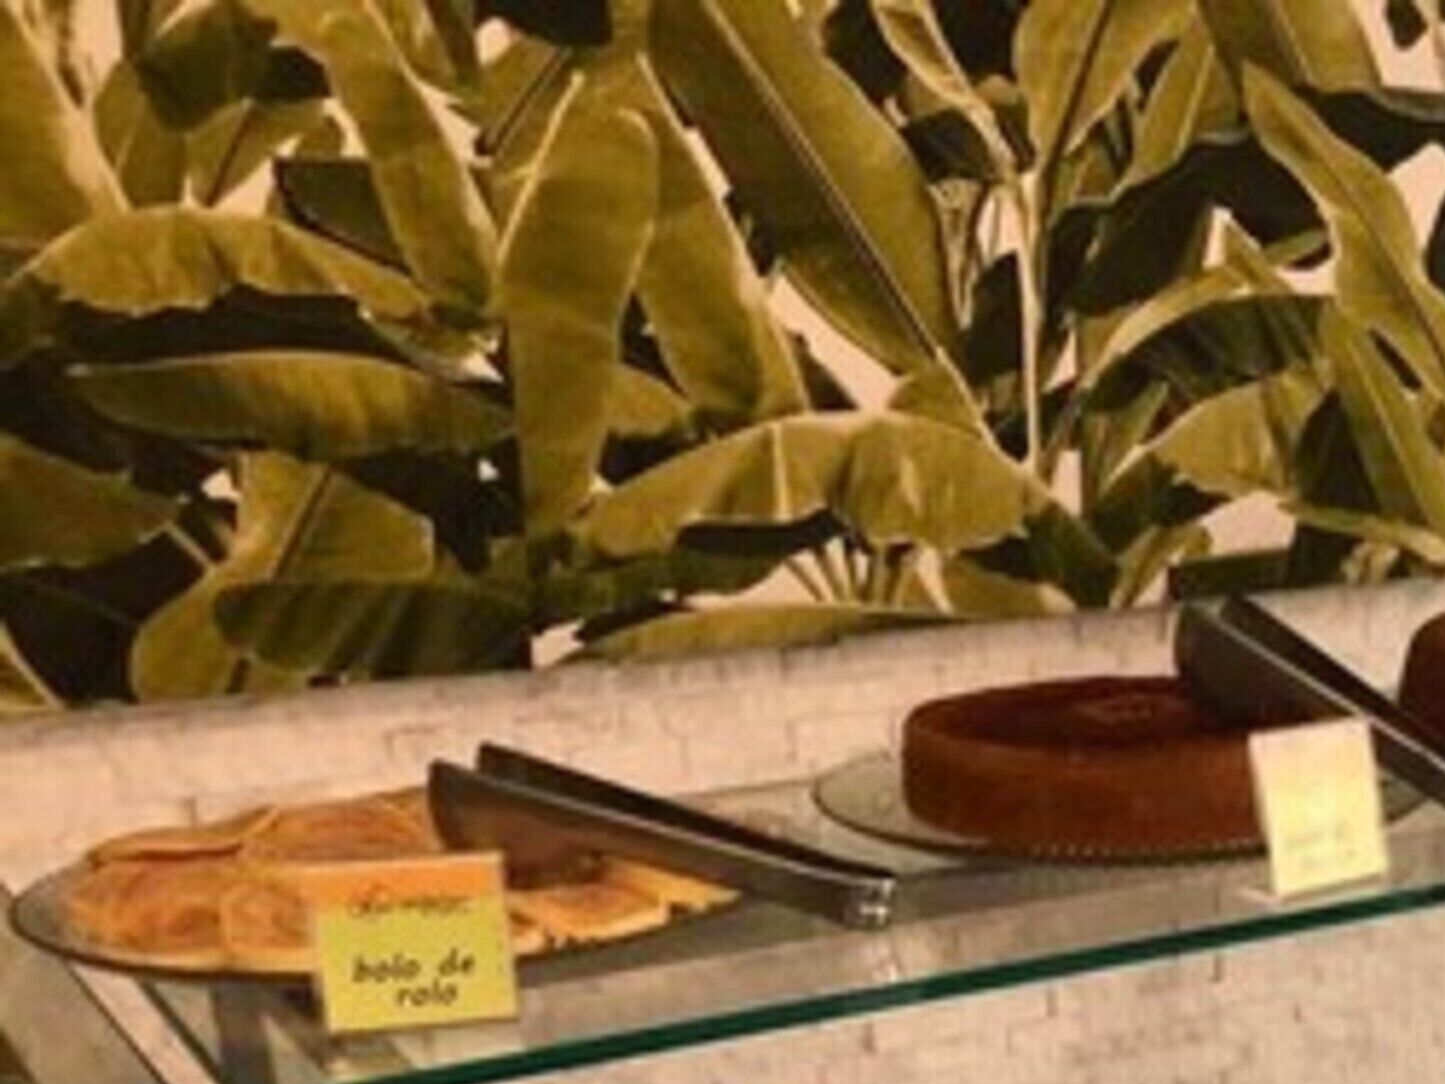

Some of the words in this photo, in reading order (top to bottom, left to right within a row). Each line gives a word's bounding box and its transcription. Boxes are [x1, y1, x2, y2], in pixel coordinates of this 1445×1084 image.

[352, 953, 421, 984] bolo
[438, 947, 475, 976] de
[397, 978, 458, 1006] rolo
